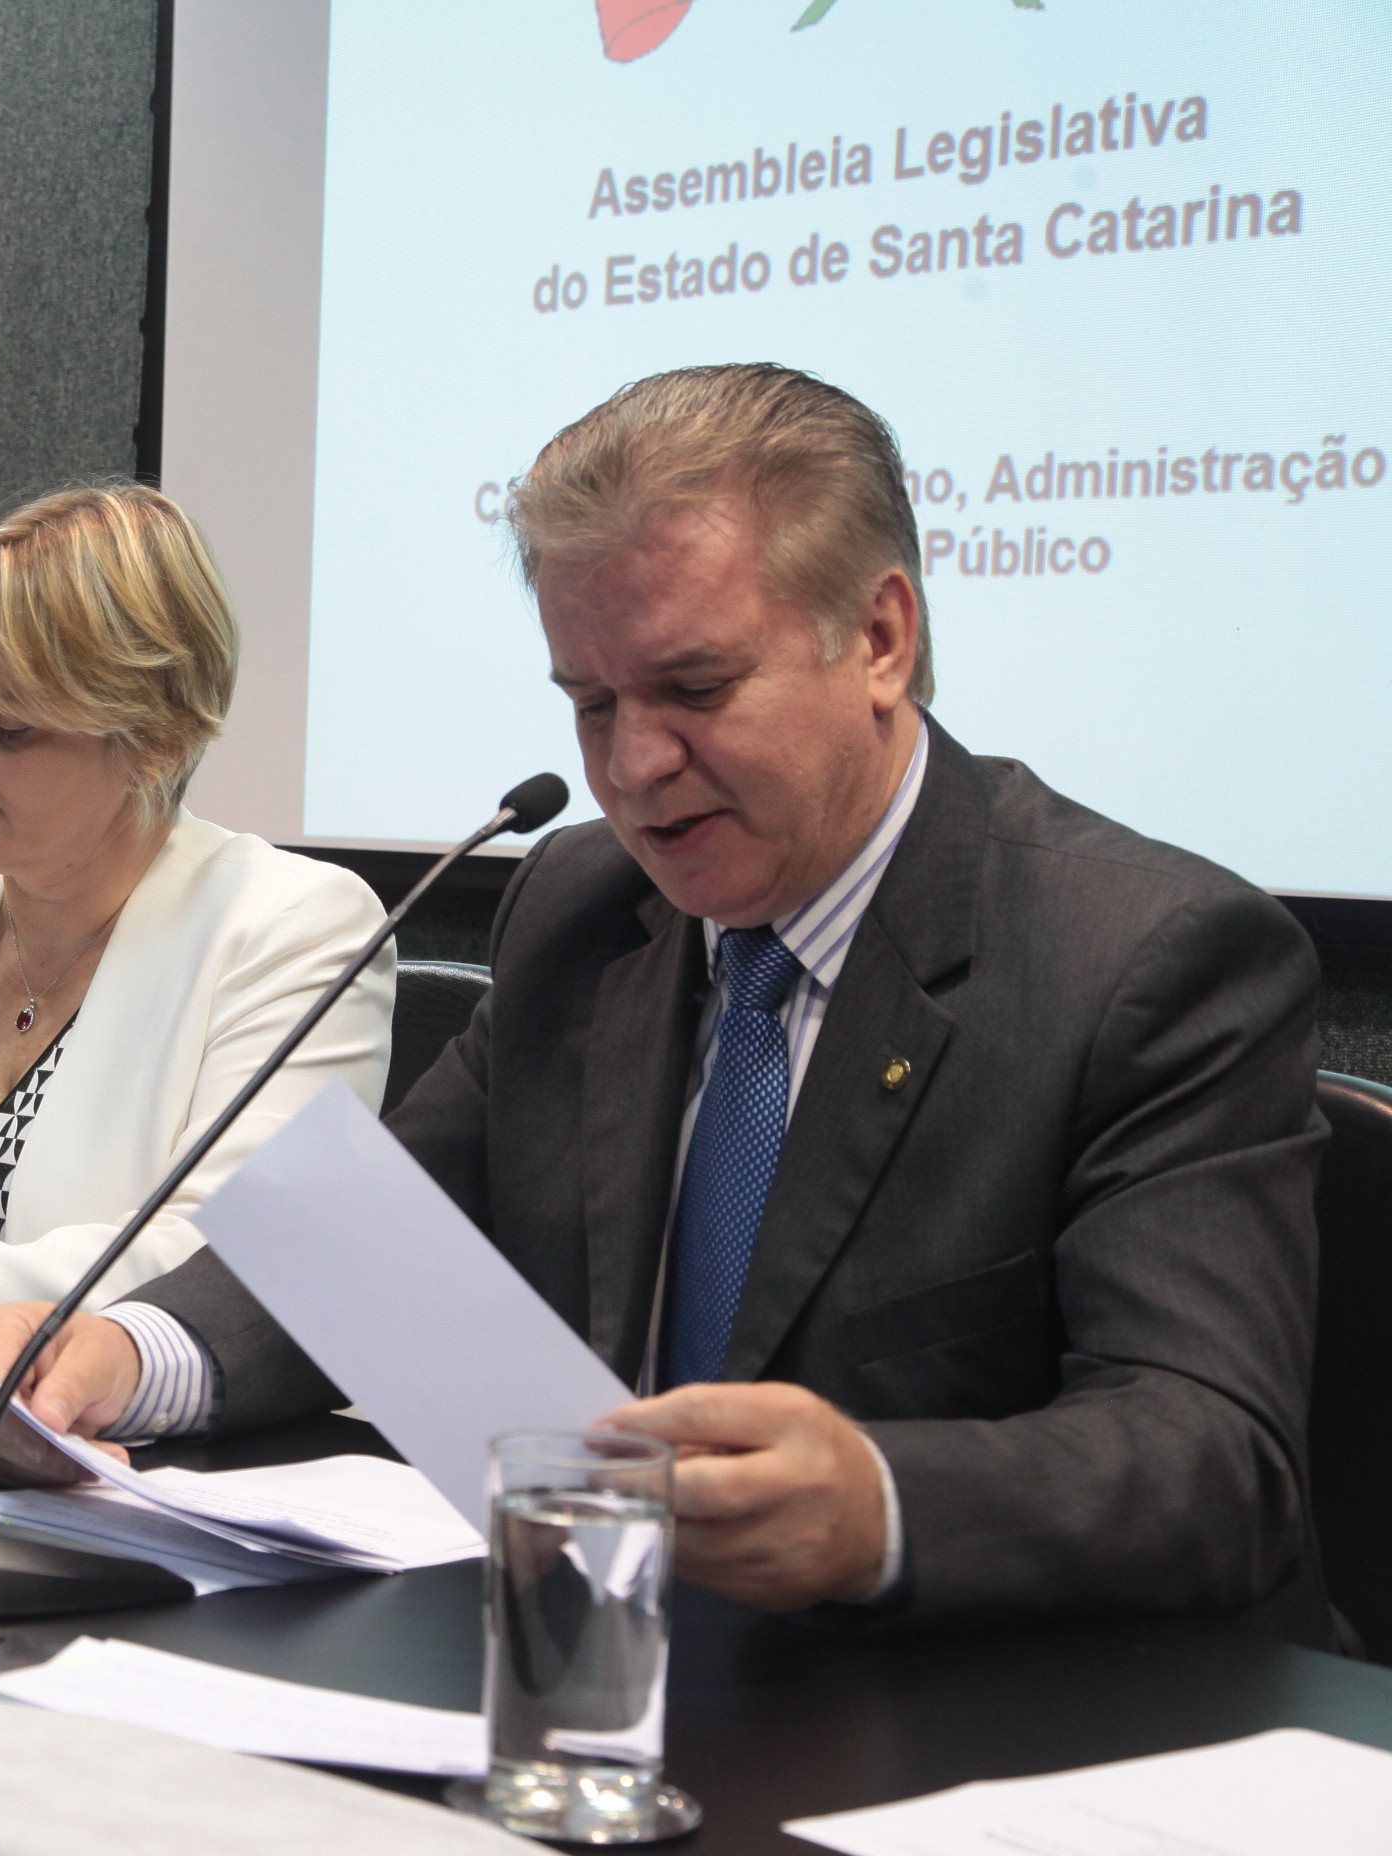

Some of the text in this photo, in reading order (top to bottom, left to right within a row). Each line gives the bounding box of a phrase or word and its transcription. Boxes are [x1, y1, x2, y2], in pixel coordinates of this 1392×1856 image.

[587, 92, 1208, 220] Assembleia Legislativa
[532, 184, 1304, 314] do Estado de Santa Catarina
[983, 433, 1388, 506] Administração
[923, 526, 1112, 577] Público
